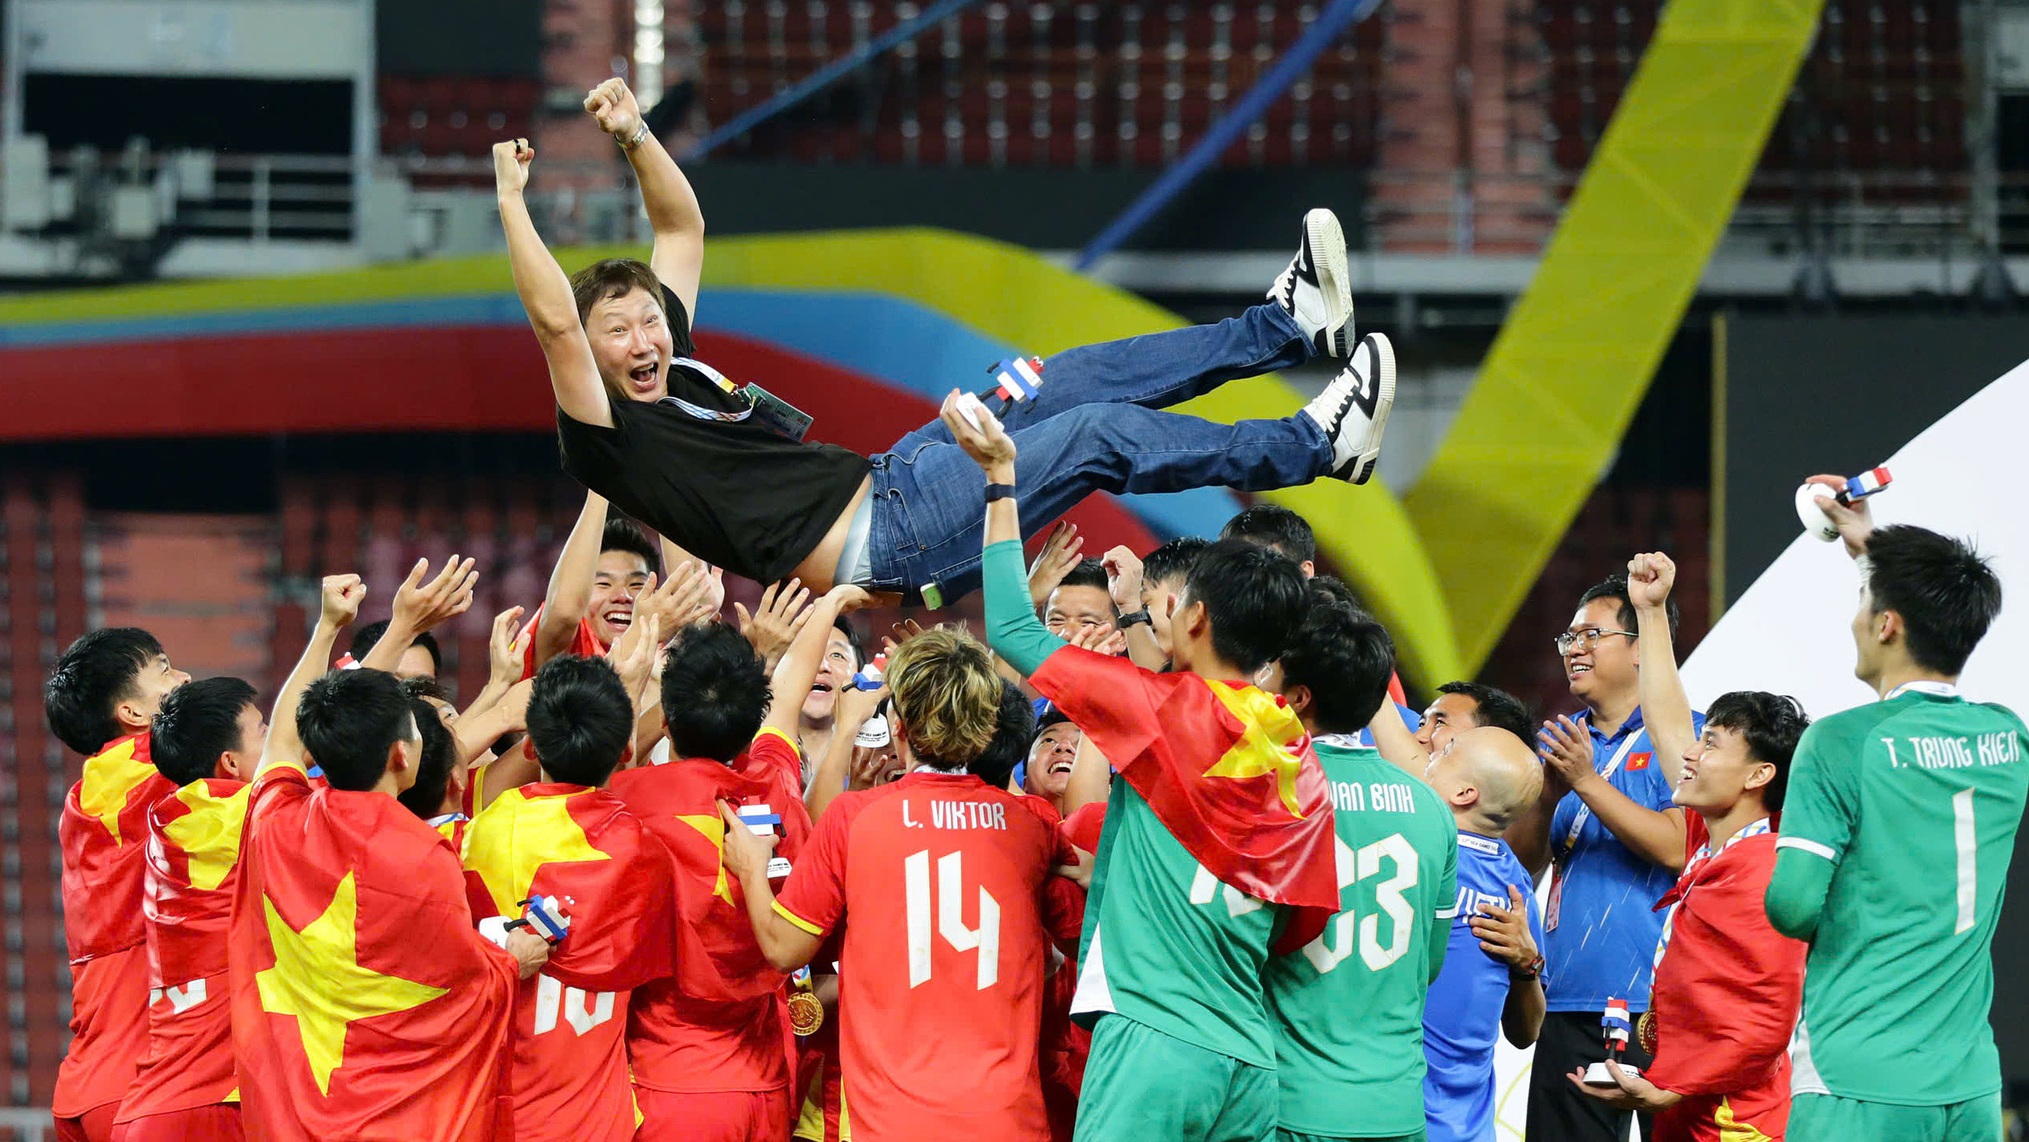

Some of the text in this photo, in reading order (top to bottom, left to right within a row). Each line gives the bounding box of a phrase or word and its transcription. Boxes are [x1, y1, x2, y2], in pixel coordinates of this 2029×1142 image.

[1881, 729, 2020, 769] T. TRUNG KIEN
[903, 799, 1006, 830] L. VIKTOR
[1370, 782, 1416, 814] BINH
[1952, 786, 1977, 936] 1
[905, 849, 1000, 990] 14
